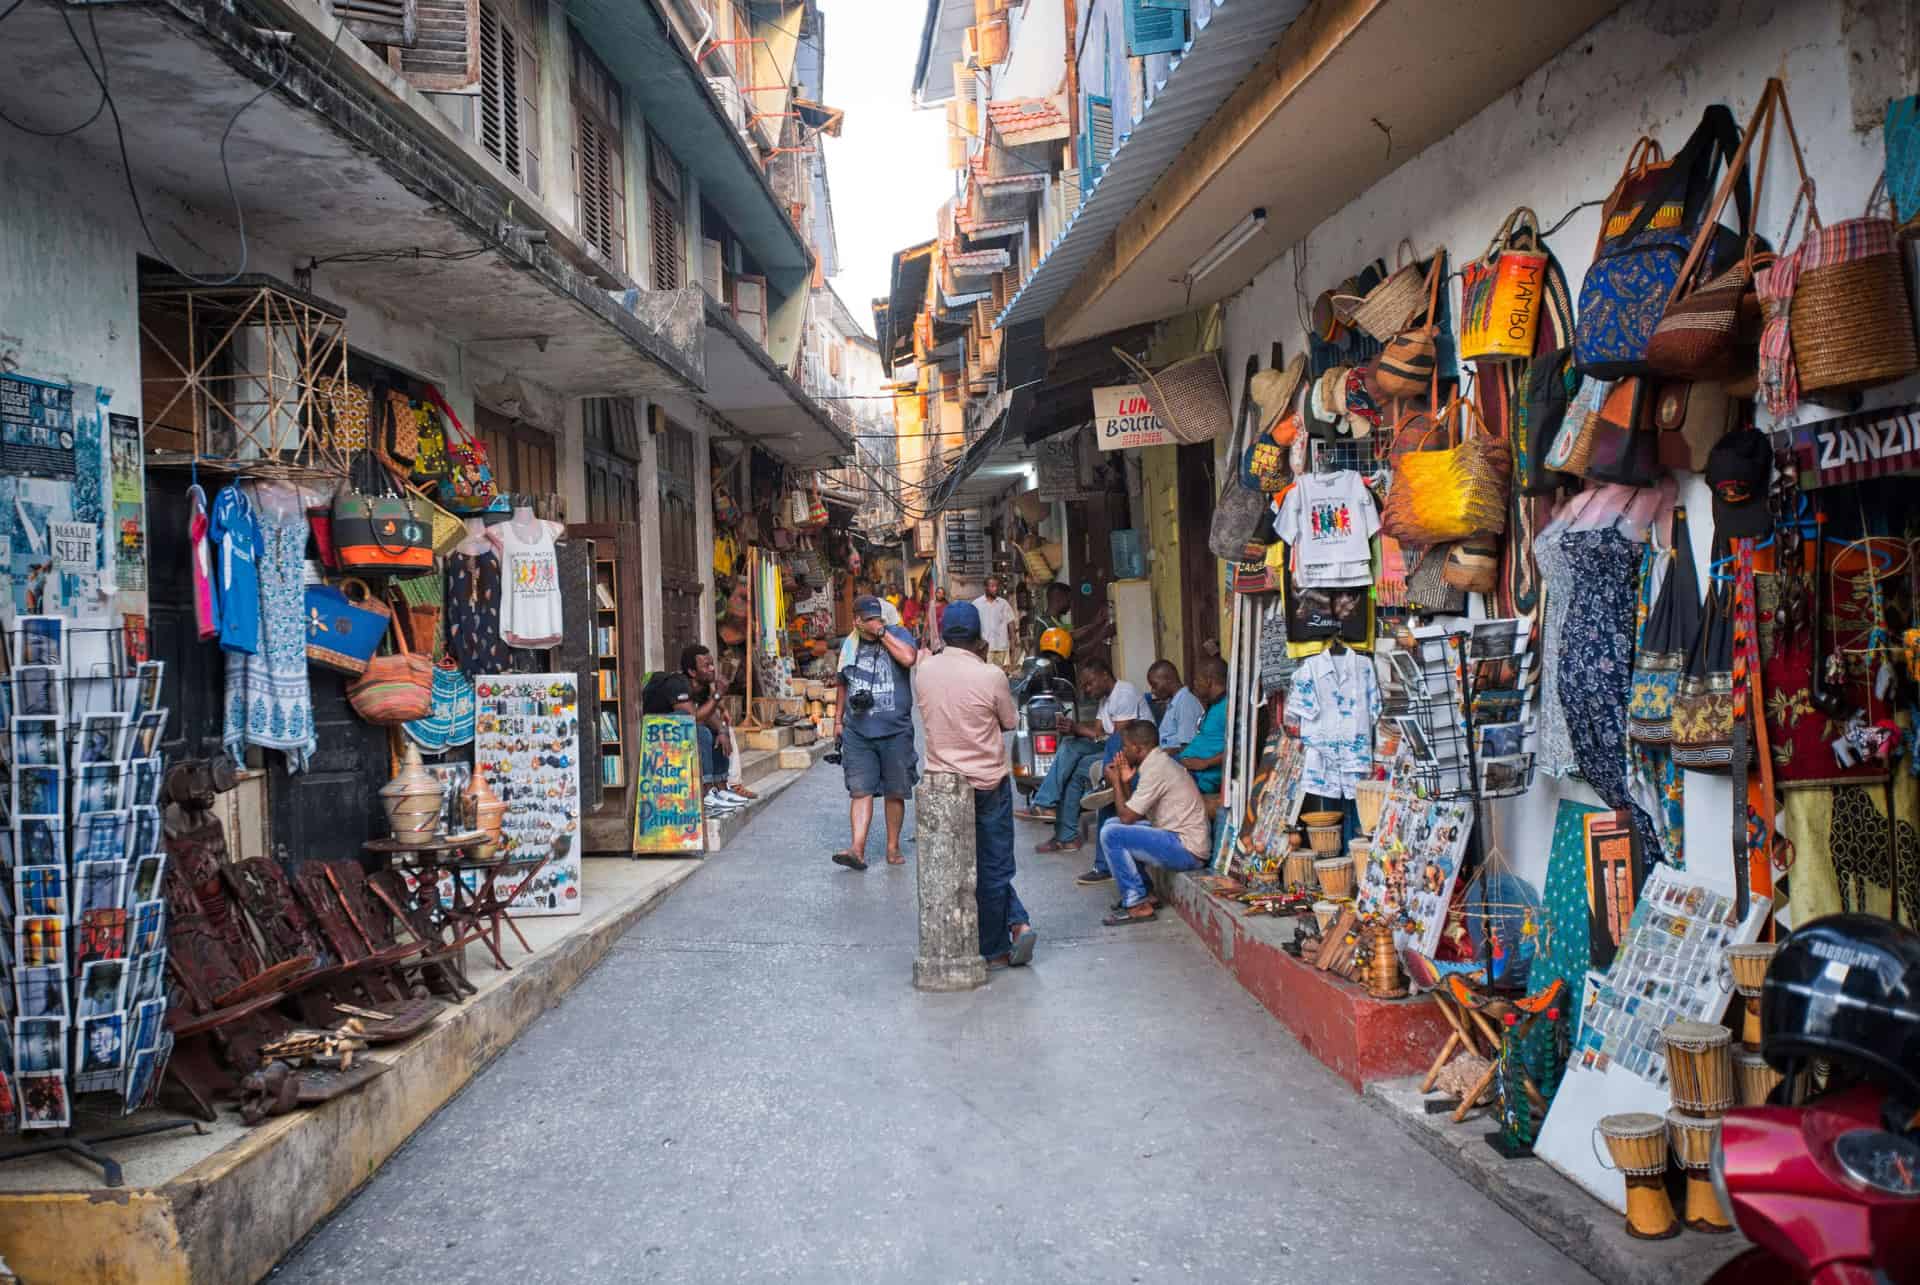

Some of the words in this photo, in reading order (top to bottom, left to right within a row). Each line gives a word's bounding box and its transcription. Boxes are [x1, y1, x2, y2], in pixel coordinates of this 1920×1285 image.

[1507, 264, 1539, 341] MAMBO
[1118, 397, 1153, 416] LUN
[56, 540, 92, 563] SEIF
[646, 722, 694, 743] BEST
[640, 751, 687, 778] Water
